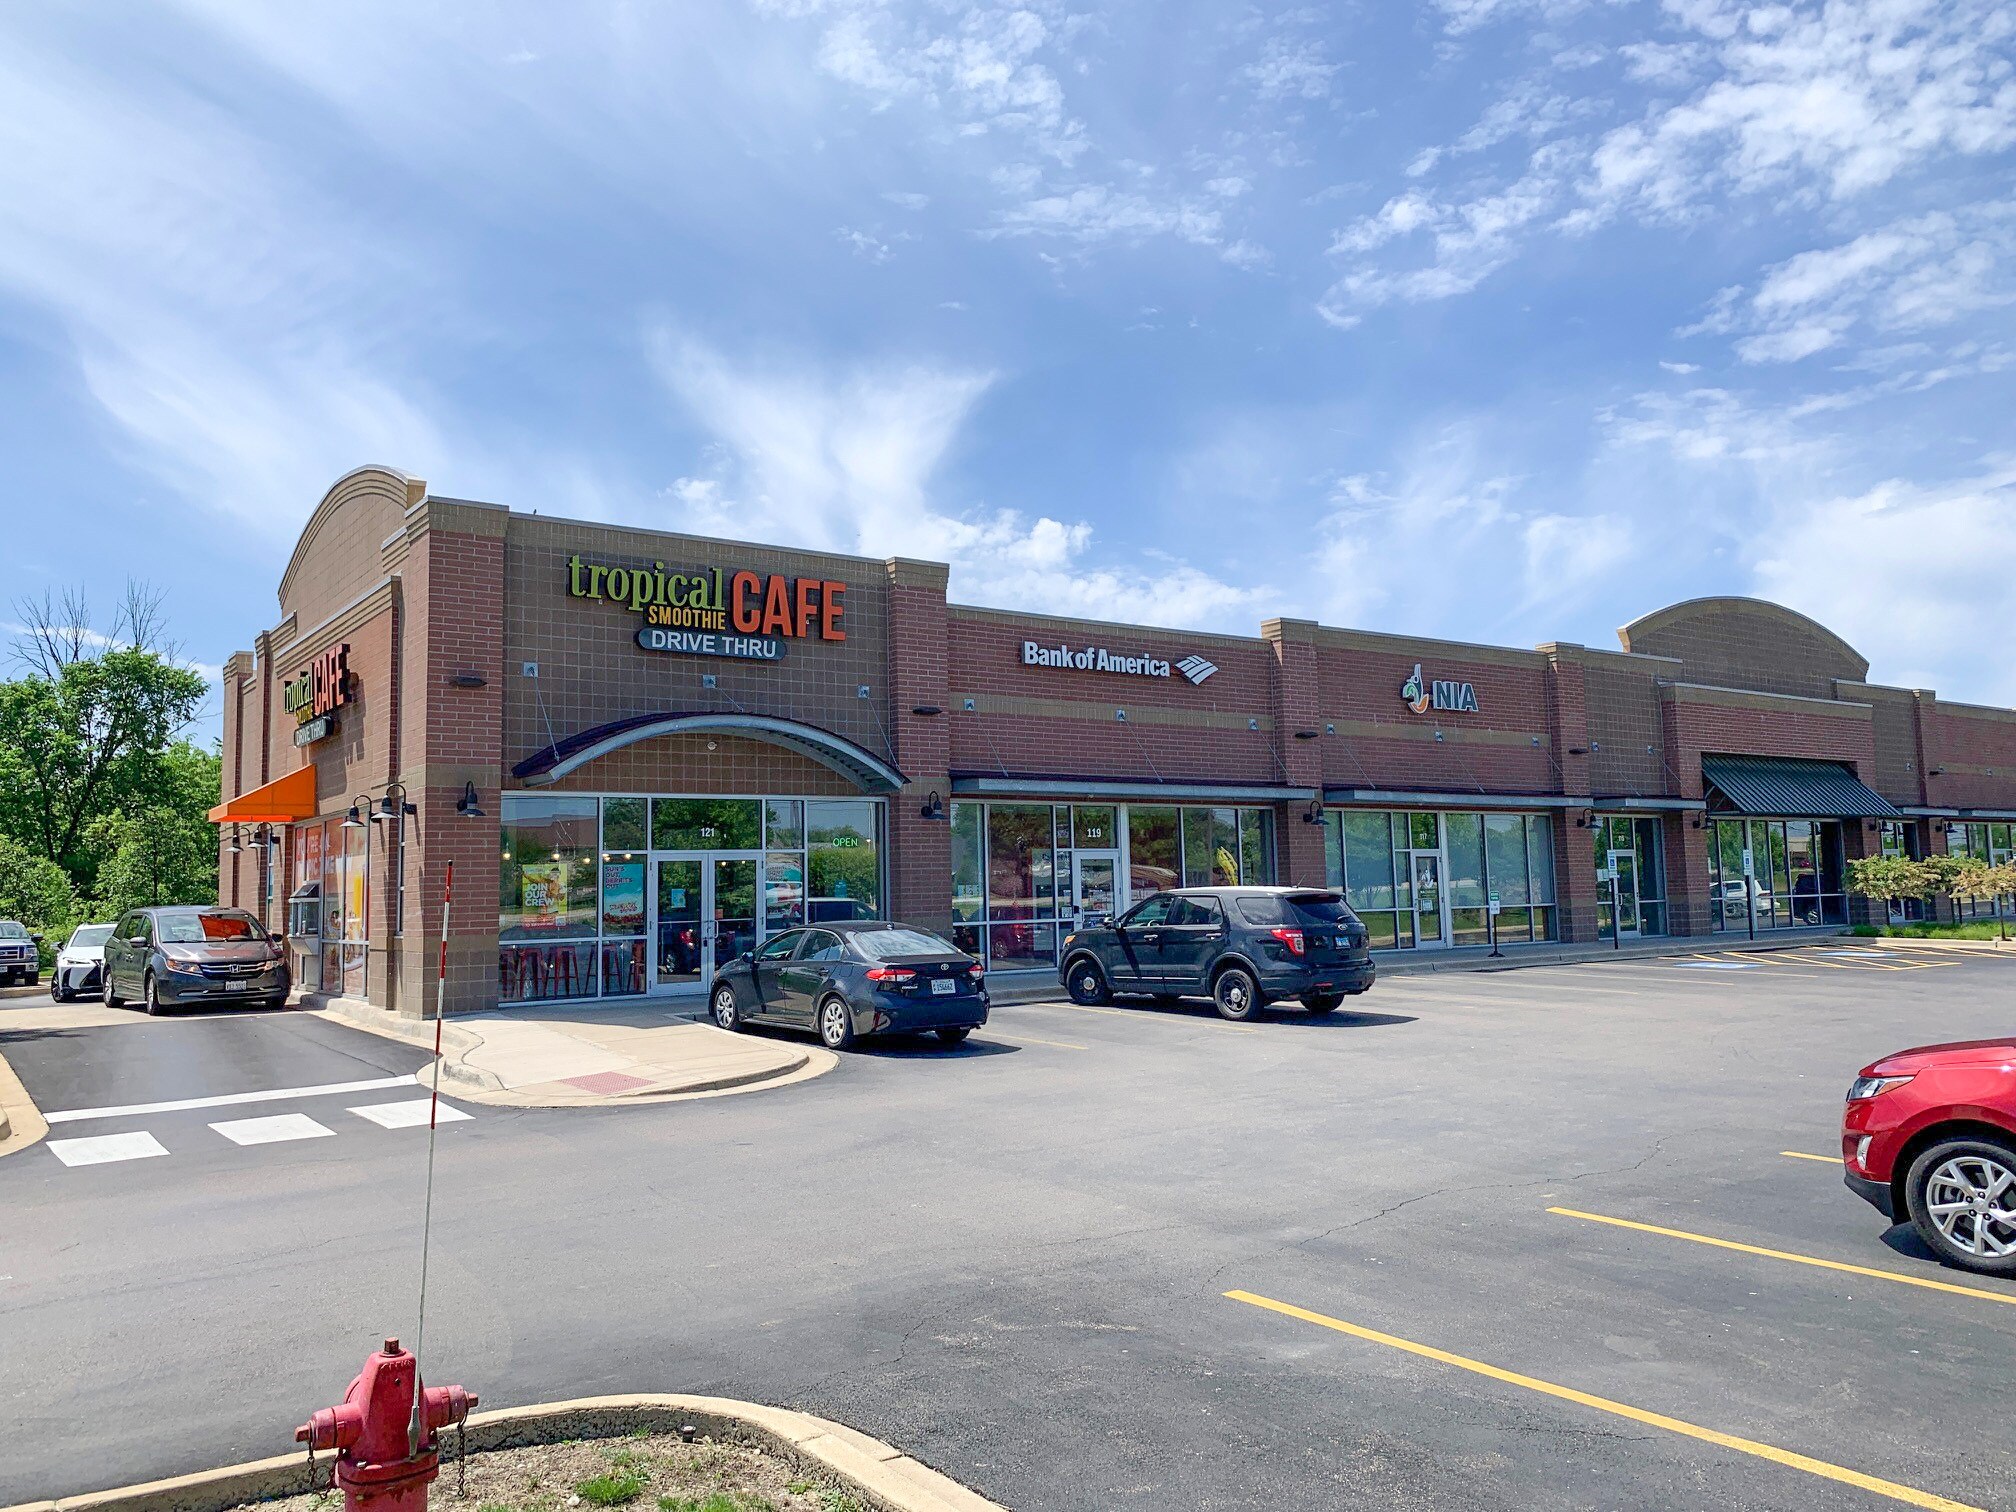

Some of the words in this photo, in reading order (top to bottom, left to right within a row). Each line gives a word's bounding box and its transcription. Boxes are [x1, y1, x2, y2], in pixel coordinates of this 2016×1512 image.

[568, 554, 725, 612] tropical
[648, 605, 726, 631] SMOOTHIE
[732, 571, 847, 641] CAFE
[651, 629, 715, 653] DRIVE
[722, 636, 777, 658] THRU
[1024, 640, 1074, 668] Bank
[1075, 647, 1095, 670] of
[1096, 648, 1170, 677] America
[313, 643, 345, 716] CAFE
[1433, 680, 1479, 712] NIA
[296, 727, 311, 746] DRIVE
[310, 718, 325, 740] THRU
[700, 827, 715, 837] 121
[832, 837, 858, 847] OPEN
[1087, 828, 1102, 838] 119
[525, 882, 548, 891] JOIN
[525, 890, 547, 899] OUR
[525, 898, 554, 907] CREW
